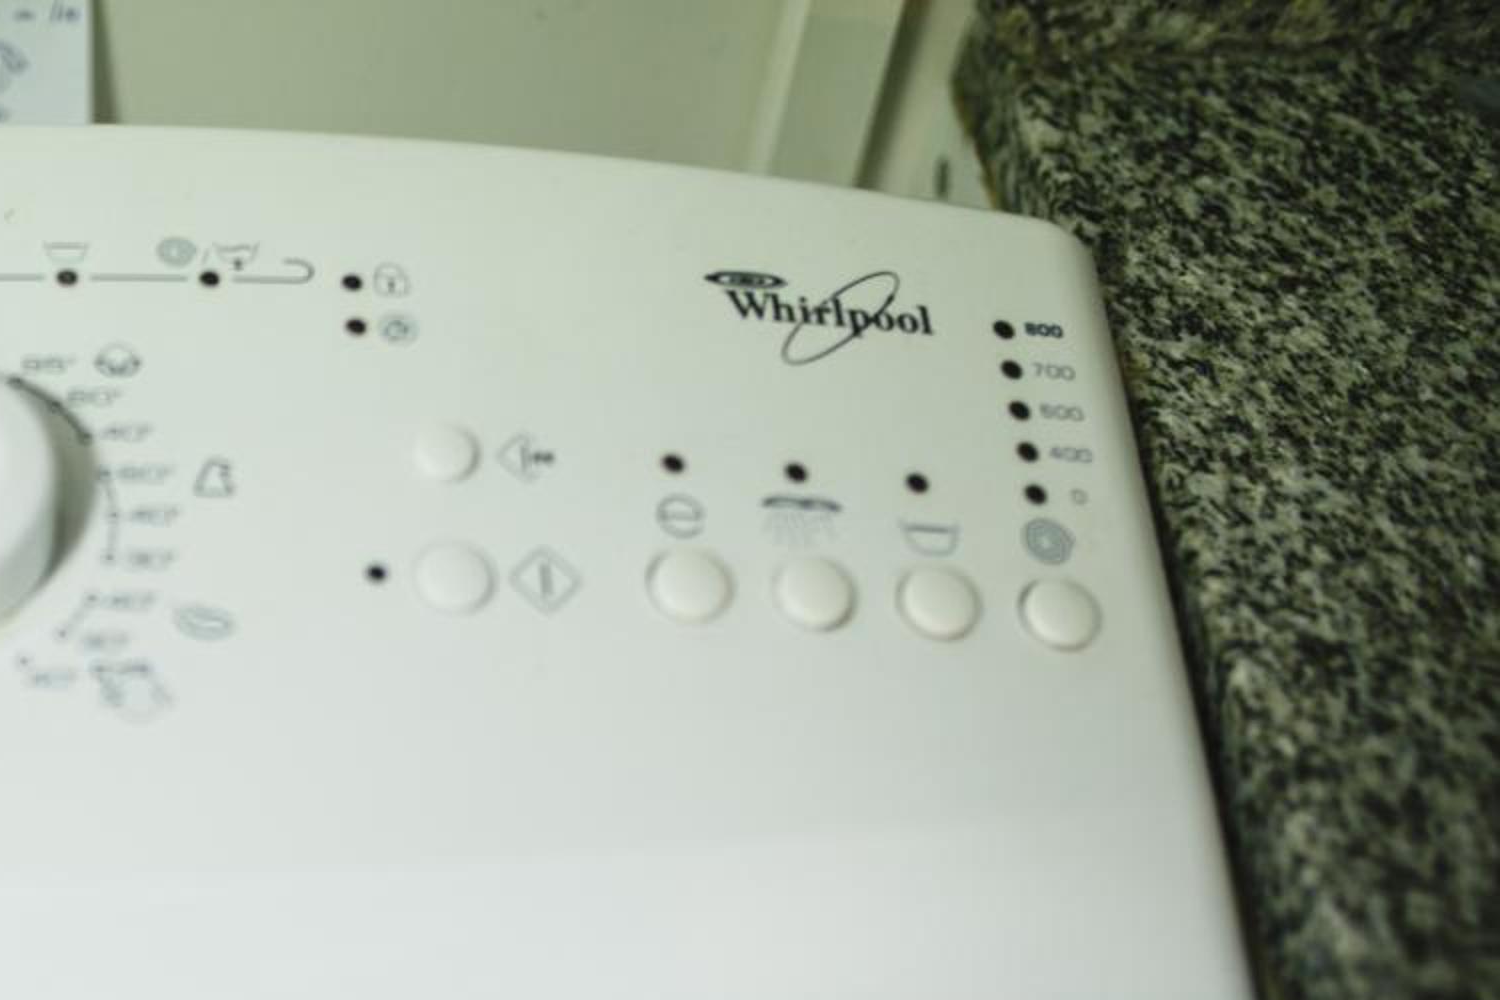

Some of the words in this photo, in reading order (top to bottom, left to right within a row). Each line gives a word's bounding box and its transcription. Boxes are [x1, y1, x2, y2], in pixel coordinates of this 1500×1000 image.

[726, 289, 935, 338] Whirlpool
[1024, 322, 1064, 339] 800
[1032, 361, 1077, 381] 700
